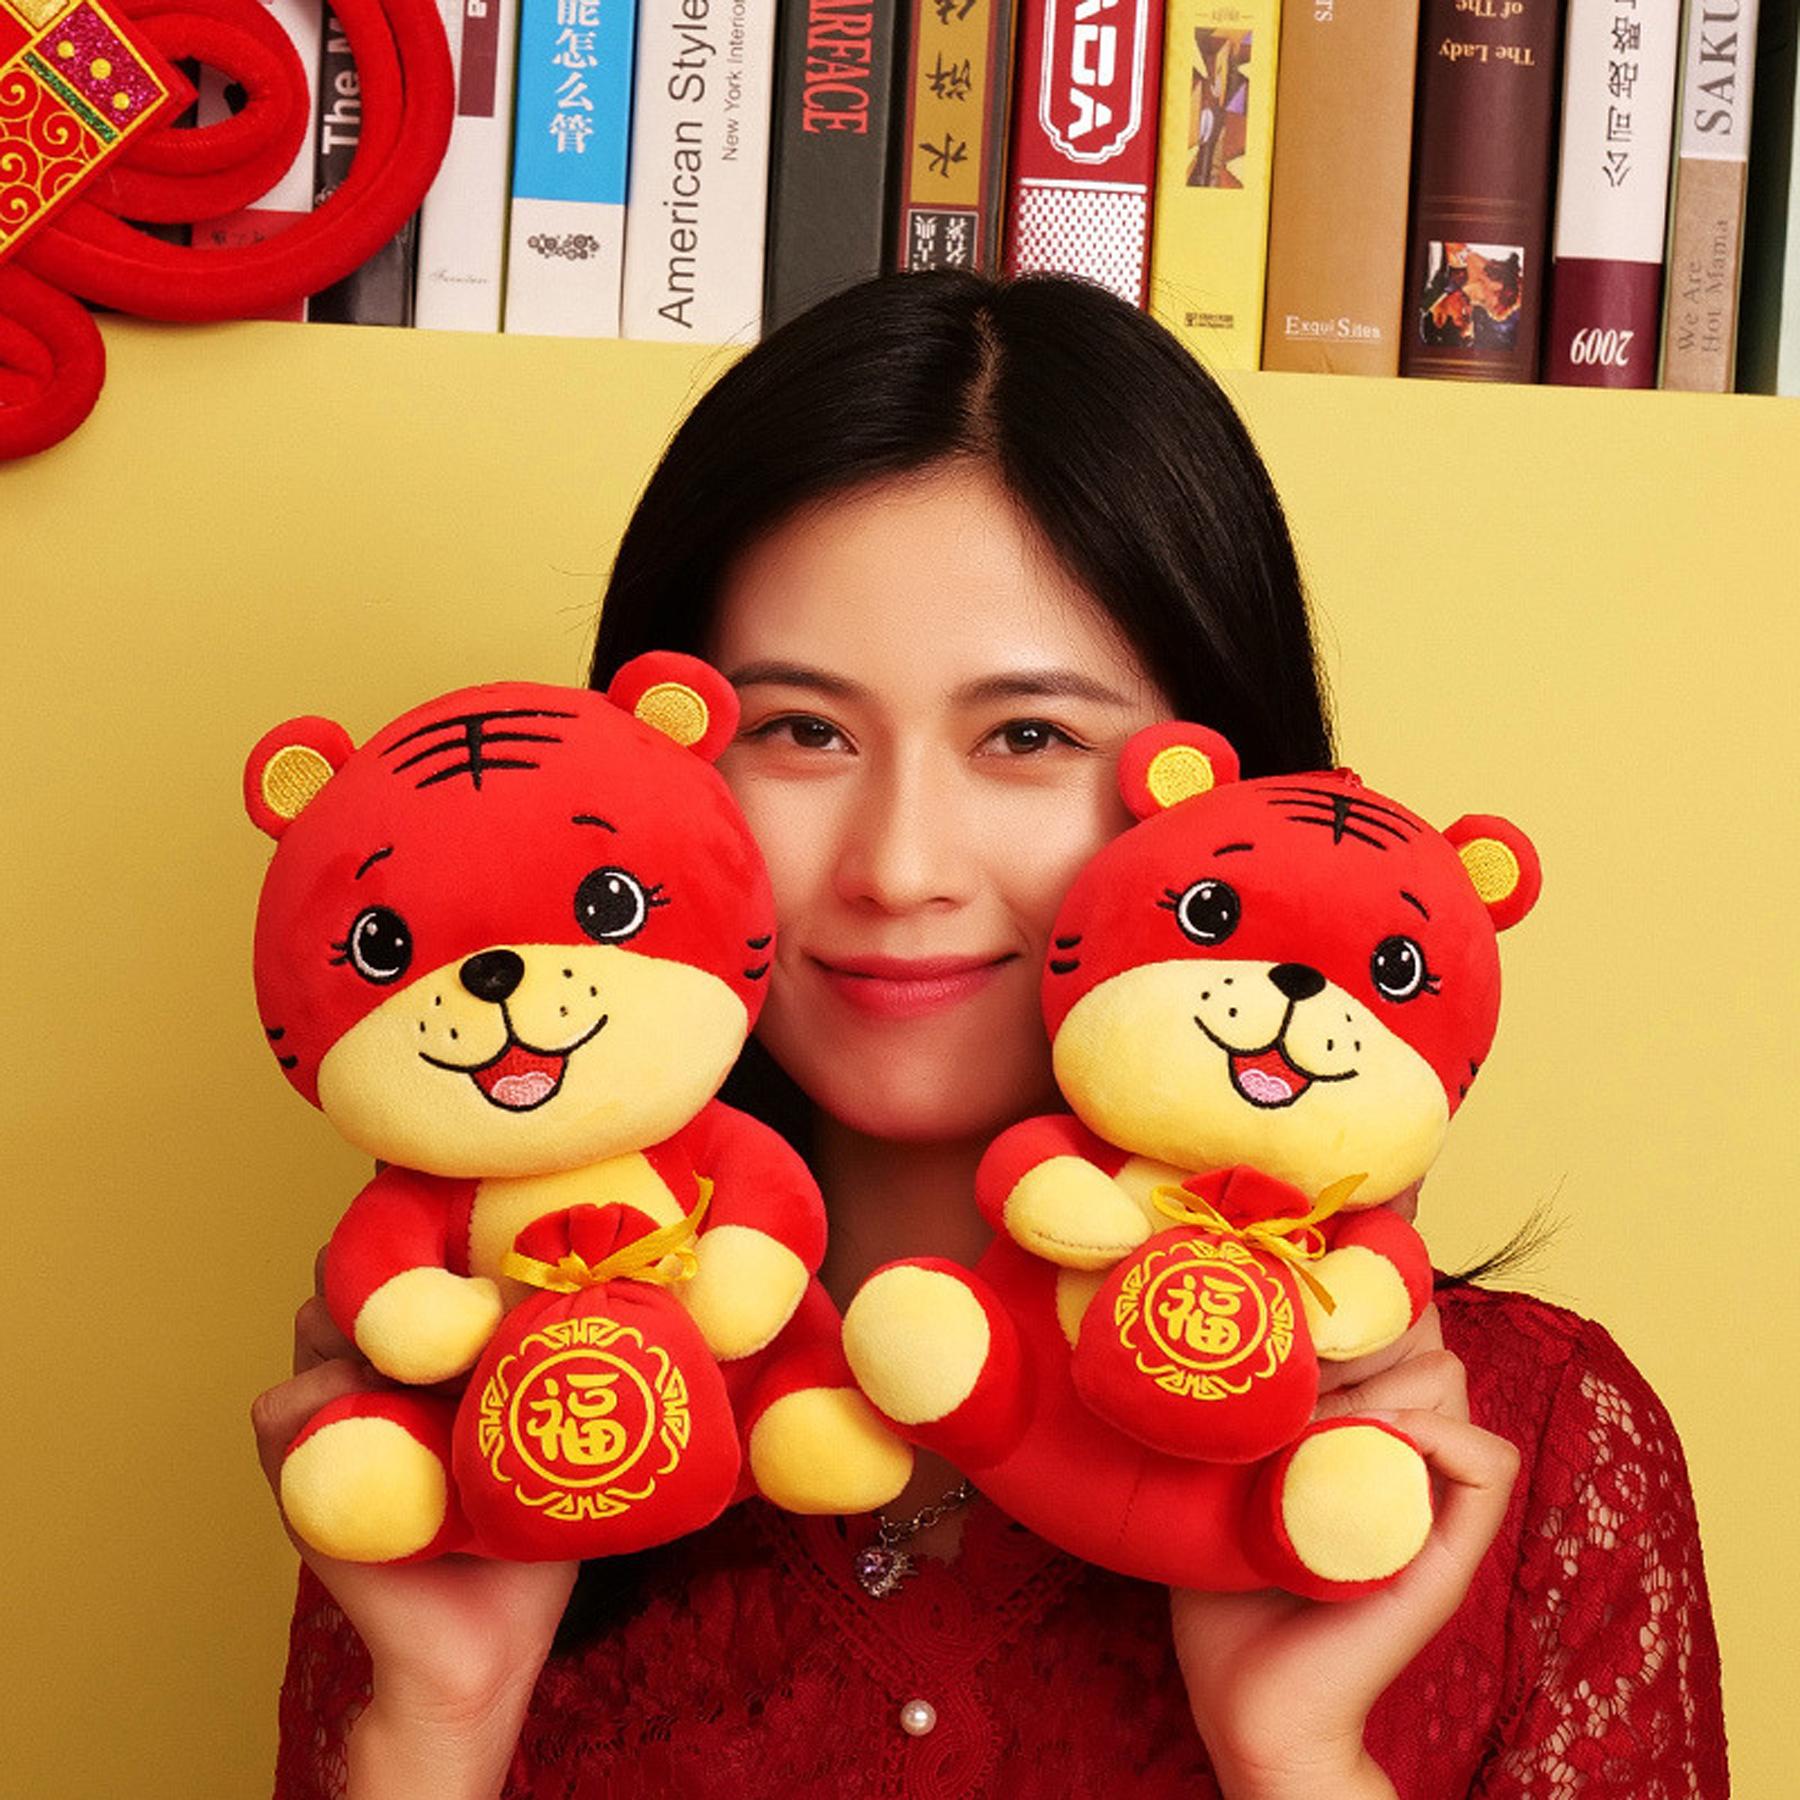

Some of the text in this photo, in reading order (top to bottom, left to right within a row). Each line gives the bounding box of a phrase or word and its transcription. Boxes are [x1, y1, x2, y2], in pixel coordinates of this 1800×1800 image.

[1454, 0, 1524, 19] of The
[1438, 38, 1535, 66] The Lady
[322, 71, 361, 154] The
[723, 72, 743, 117] York
[1601, 0, 1641, 188] 公司战略
[657, 0, 717, 329] American Style
[721, 118, 740, 161] New
[1704, 219, 1729, 296] Mama
[1677, 260, 1702, 353] We Are
[1569, 328, 1635, 367] 2009
[1157, 1273, 1247, 1355] 福
[525, 1372, 628, 1467] 福
